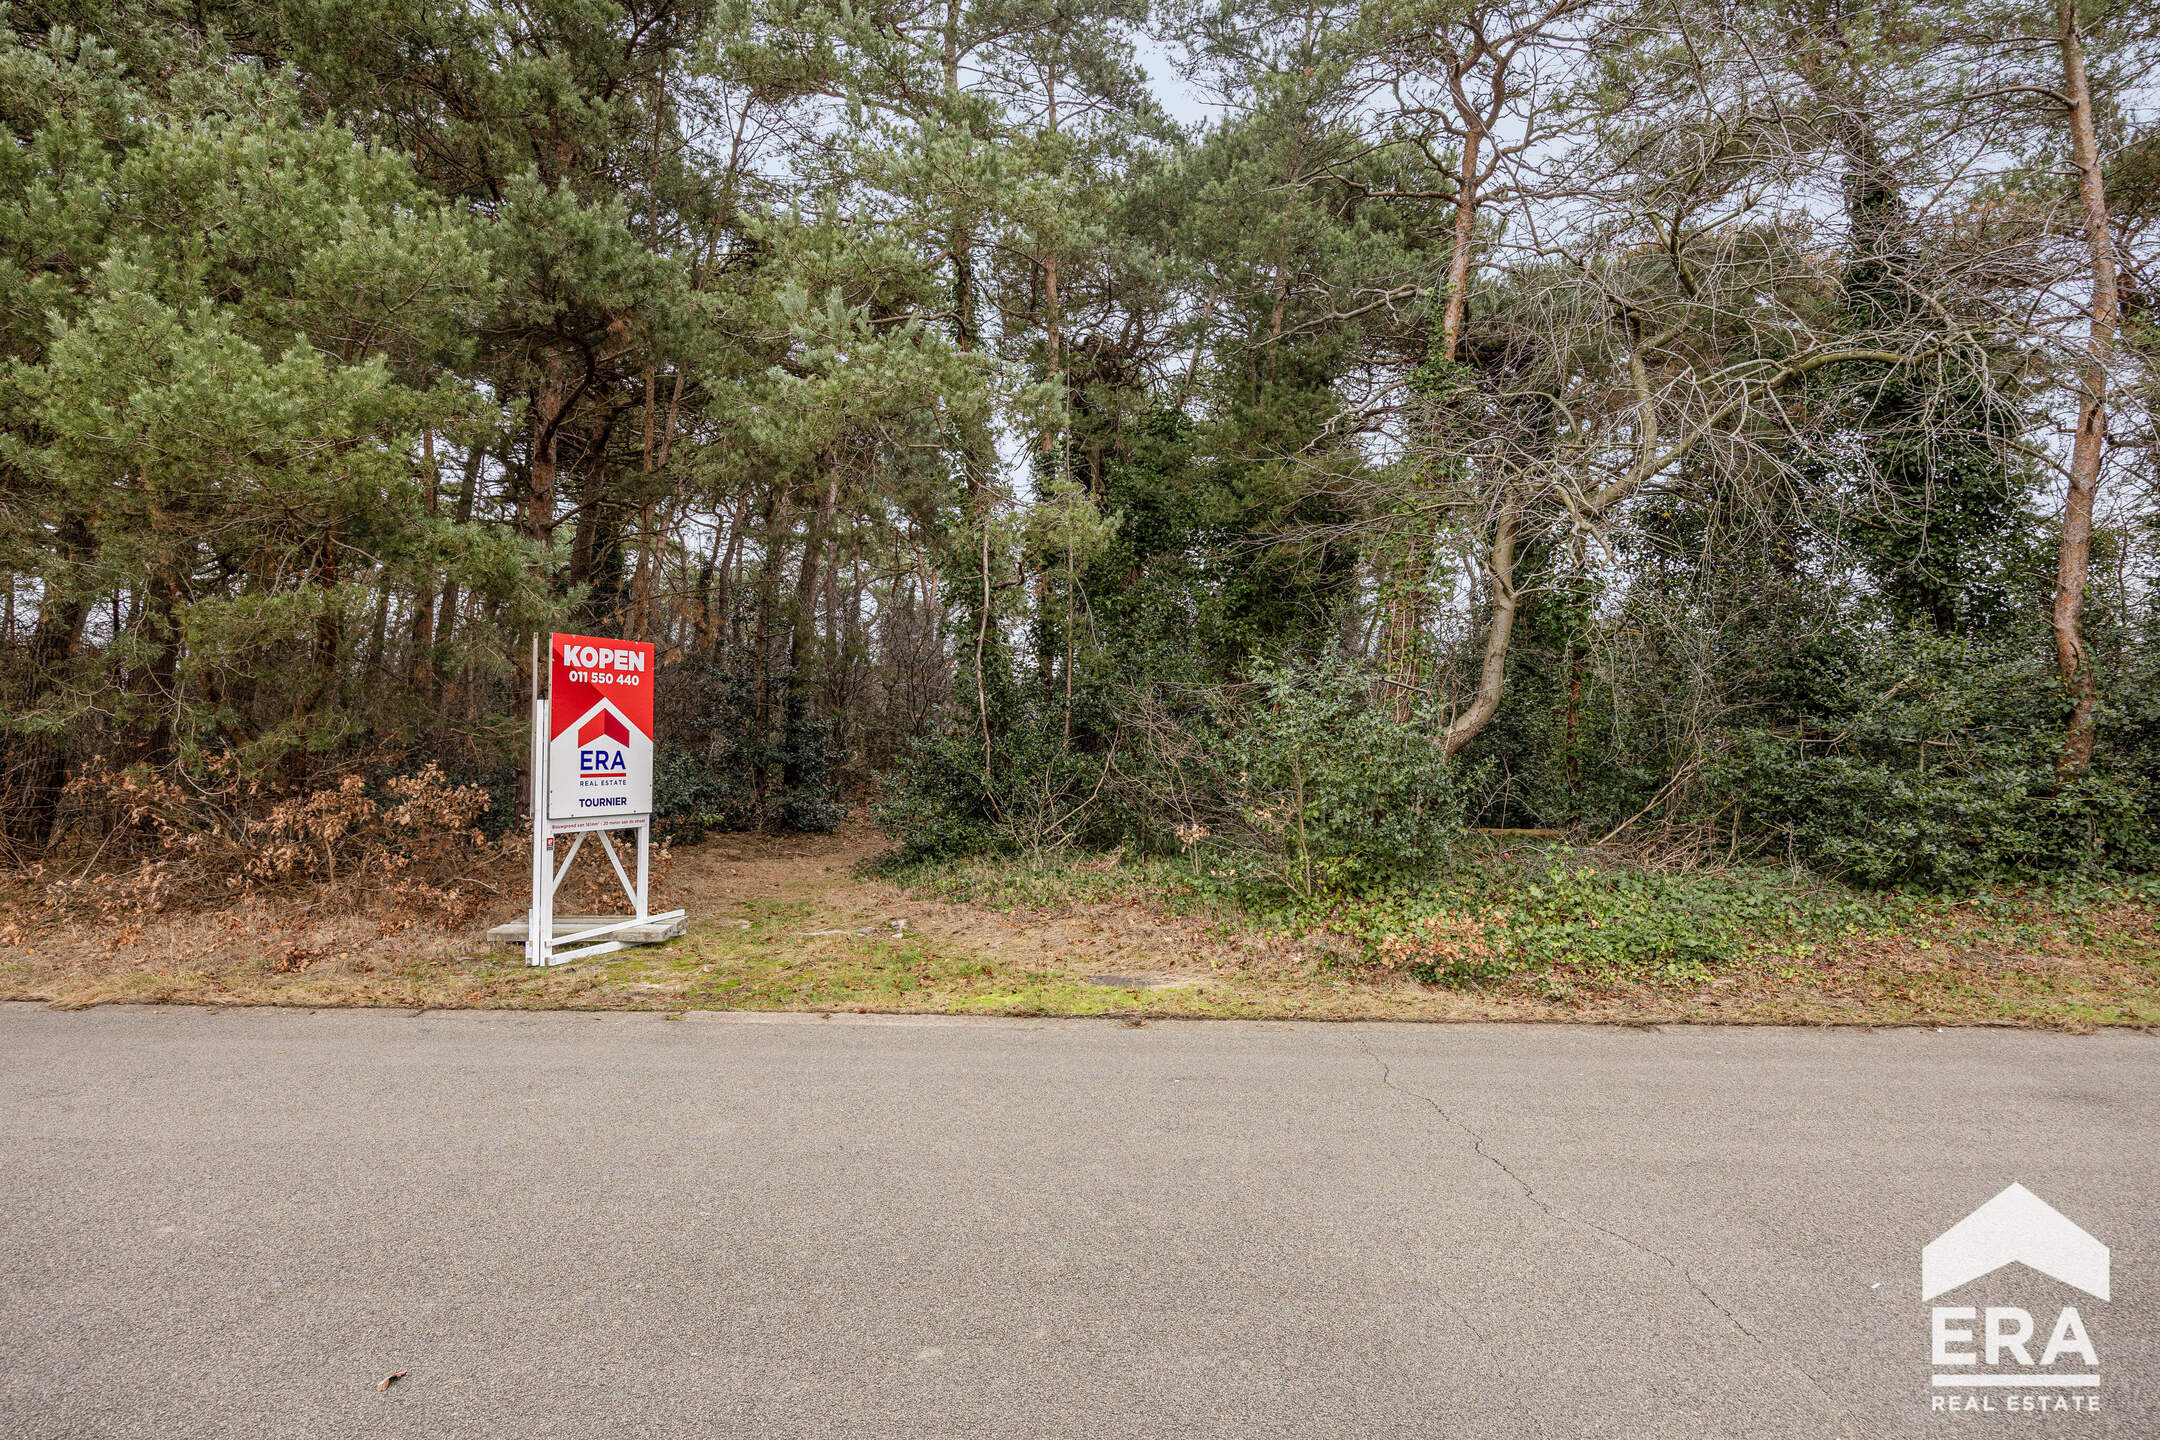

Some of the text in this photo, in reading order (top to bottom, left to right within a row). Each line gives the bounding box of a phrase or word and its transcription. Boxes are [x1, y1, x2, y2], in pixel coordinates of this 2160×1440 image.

[563, 644, 645, 672] KOPEN
[569, 670, 640, 686] 011 550 440
[580, 750, 626, 770] ERA
[579, 797, 627, 808] TOURNIER
